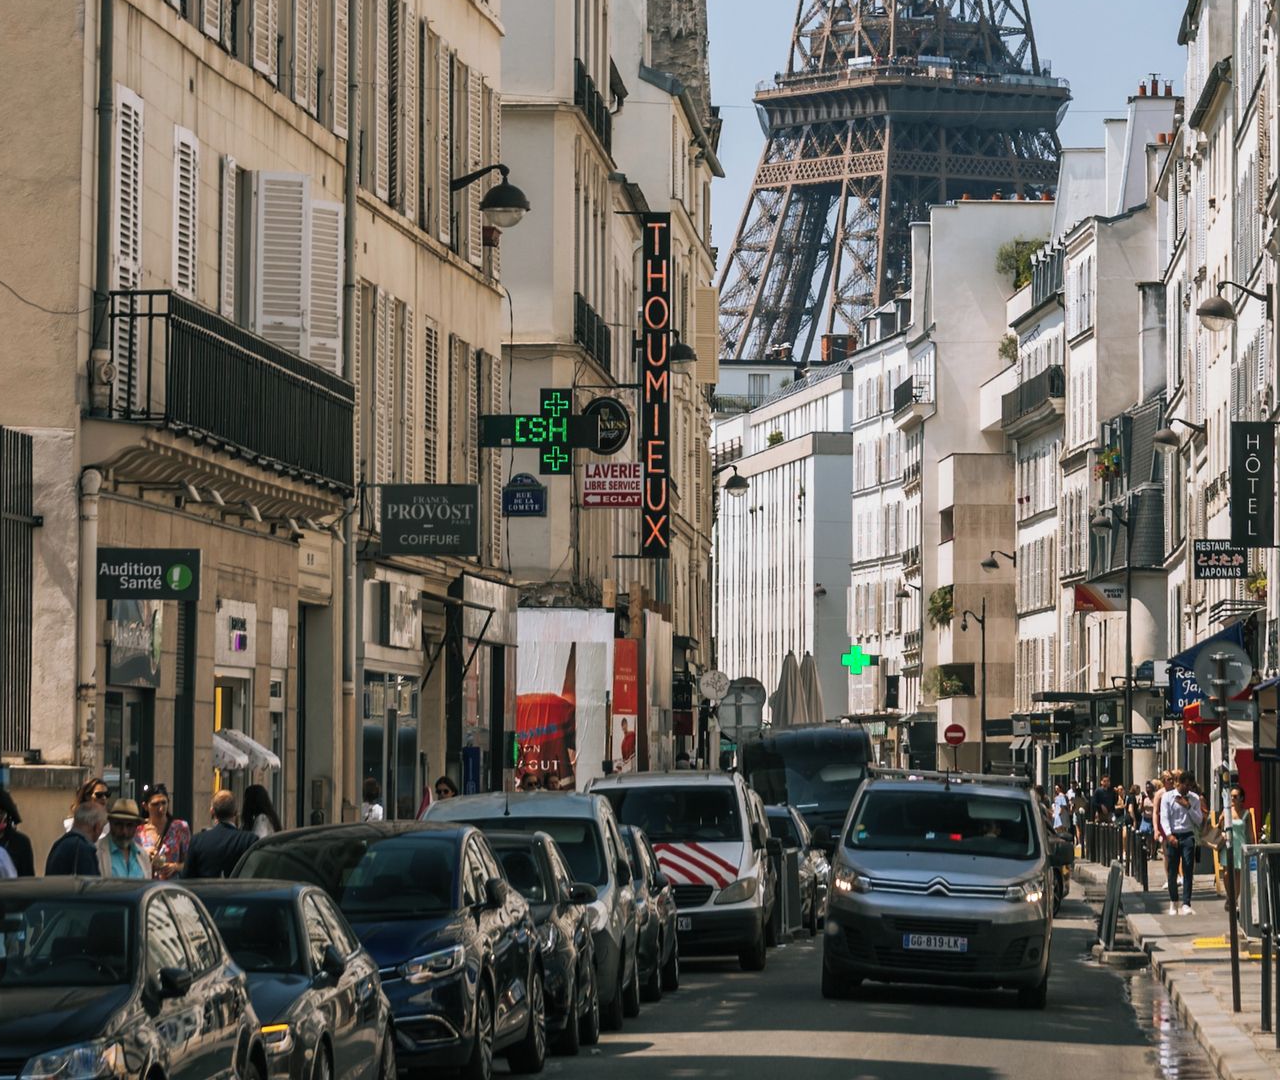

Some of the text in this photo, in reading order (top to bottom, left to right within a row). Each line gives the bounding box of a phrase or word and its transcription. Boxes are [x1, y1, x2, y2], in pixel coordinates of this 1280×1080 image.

[644, 223, 669, 548] THOUMIEUX
[585, 464, 641, 479] LAVERIE
[584, 481, 641, 490] LIBRE SERVICE
[1245, 433, 1261, 536] HÔTEL
[602, 495, 640, 503] ECLAT
[387, 504, 474, 519] PROVOST
[400, 534, 460, 545] COIFFURE
[1195, 541, 1245, 551] RESTAUR
[1197, 553, 1245, 566] とよたか
[99, 562, 162, 575] Audition
[1199, 567, 1241, 577] JAPONAIS
[120, 576, 162, 589] Santé
